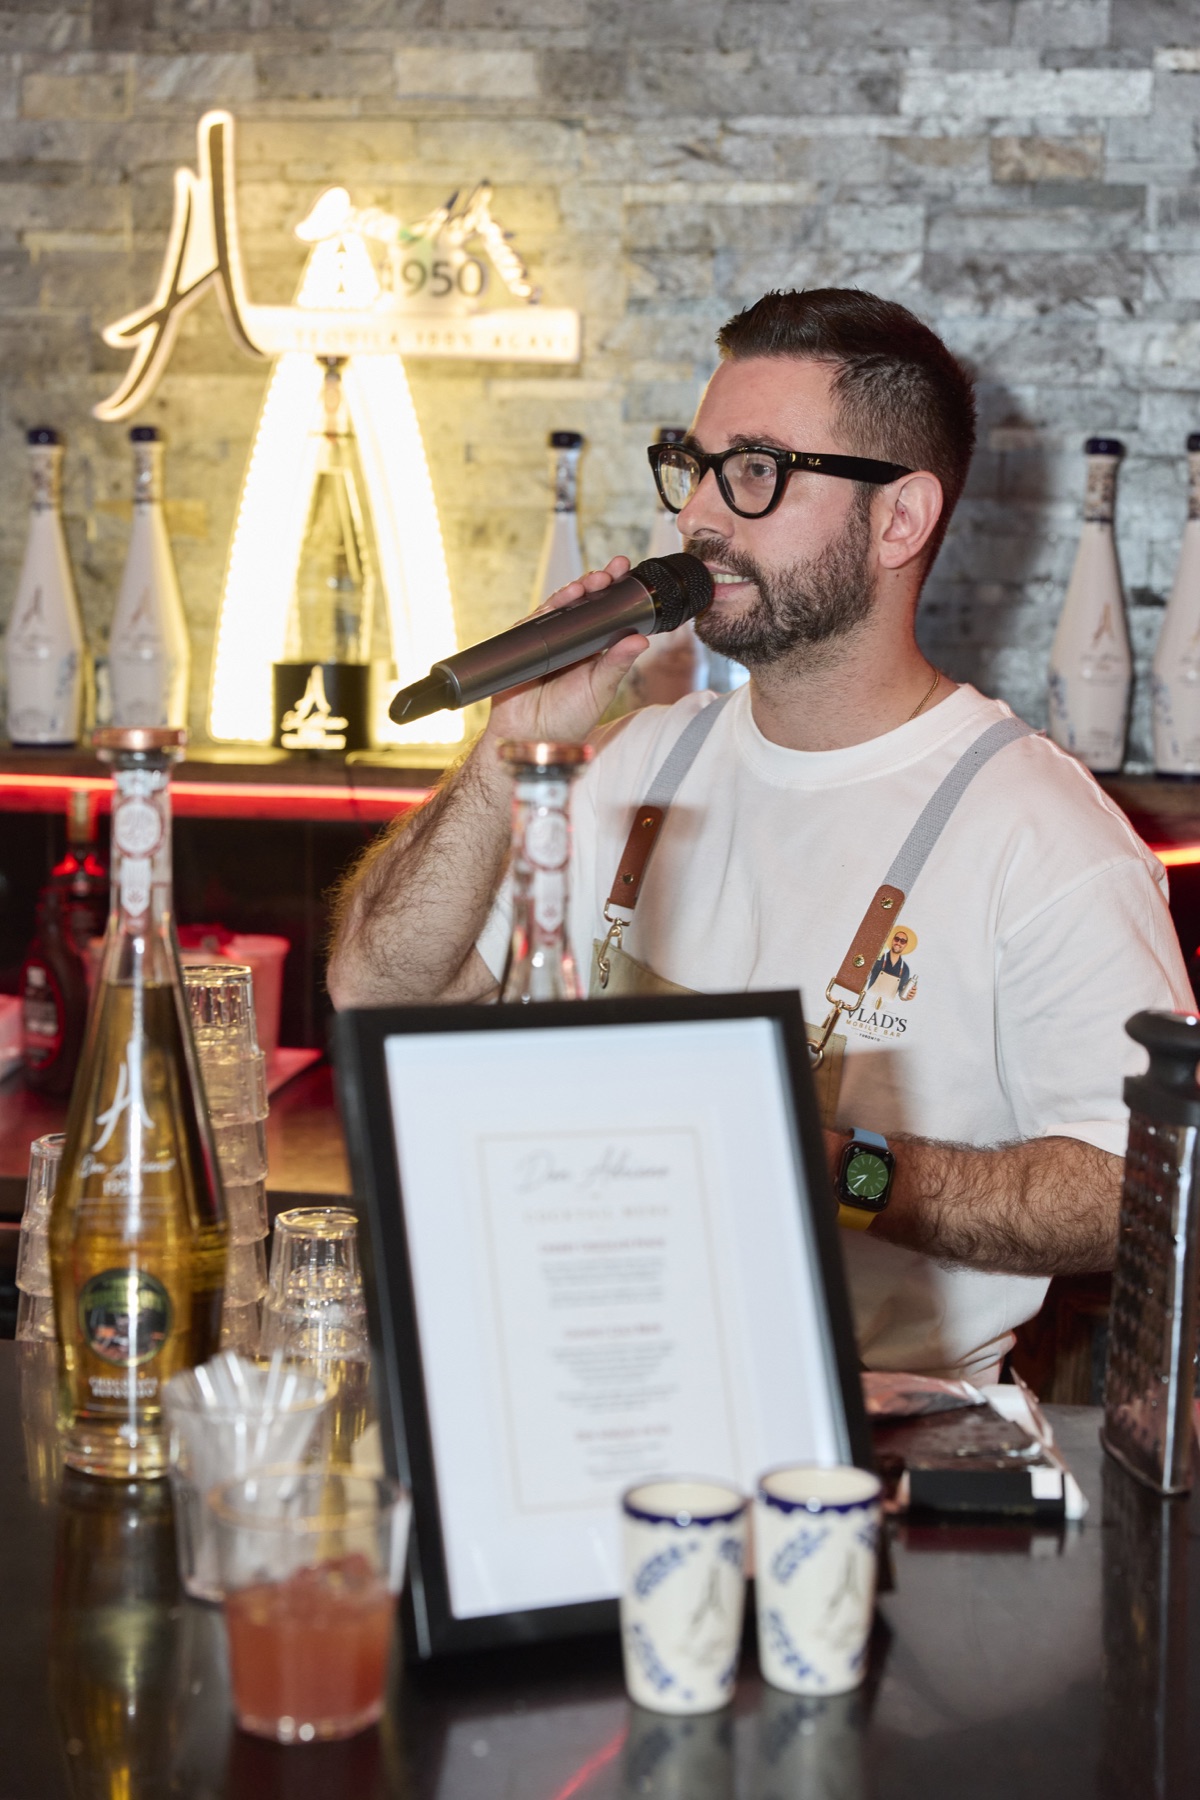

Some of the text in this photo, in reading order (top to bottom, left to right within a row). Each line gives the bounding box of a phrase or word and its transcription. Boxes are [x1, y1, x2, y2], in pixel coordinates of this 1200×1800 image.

[846, 1019, 902, 1039] MOBILE BAR
[847, 1007, 908, 1033] VLAD'S
